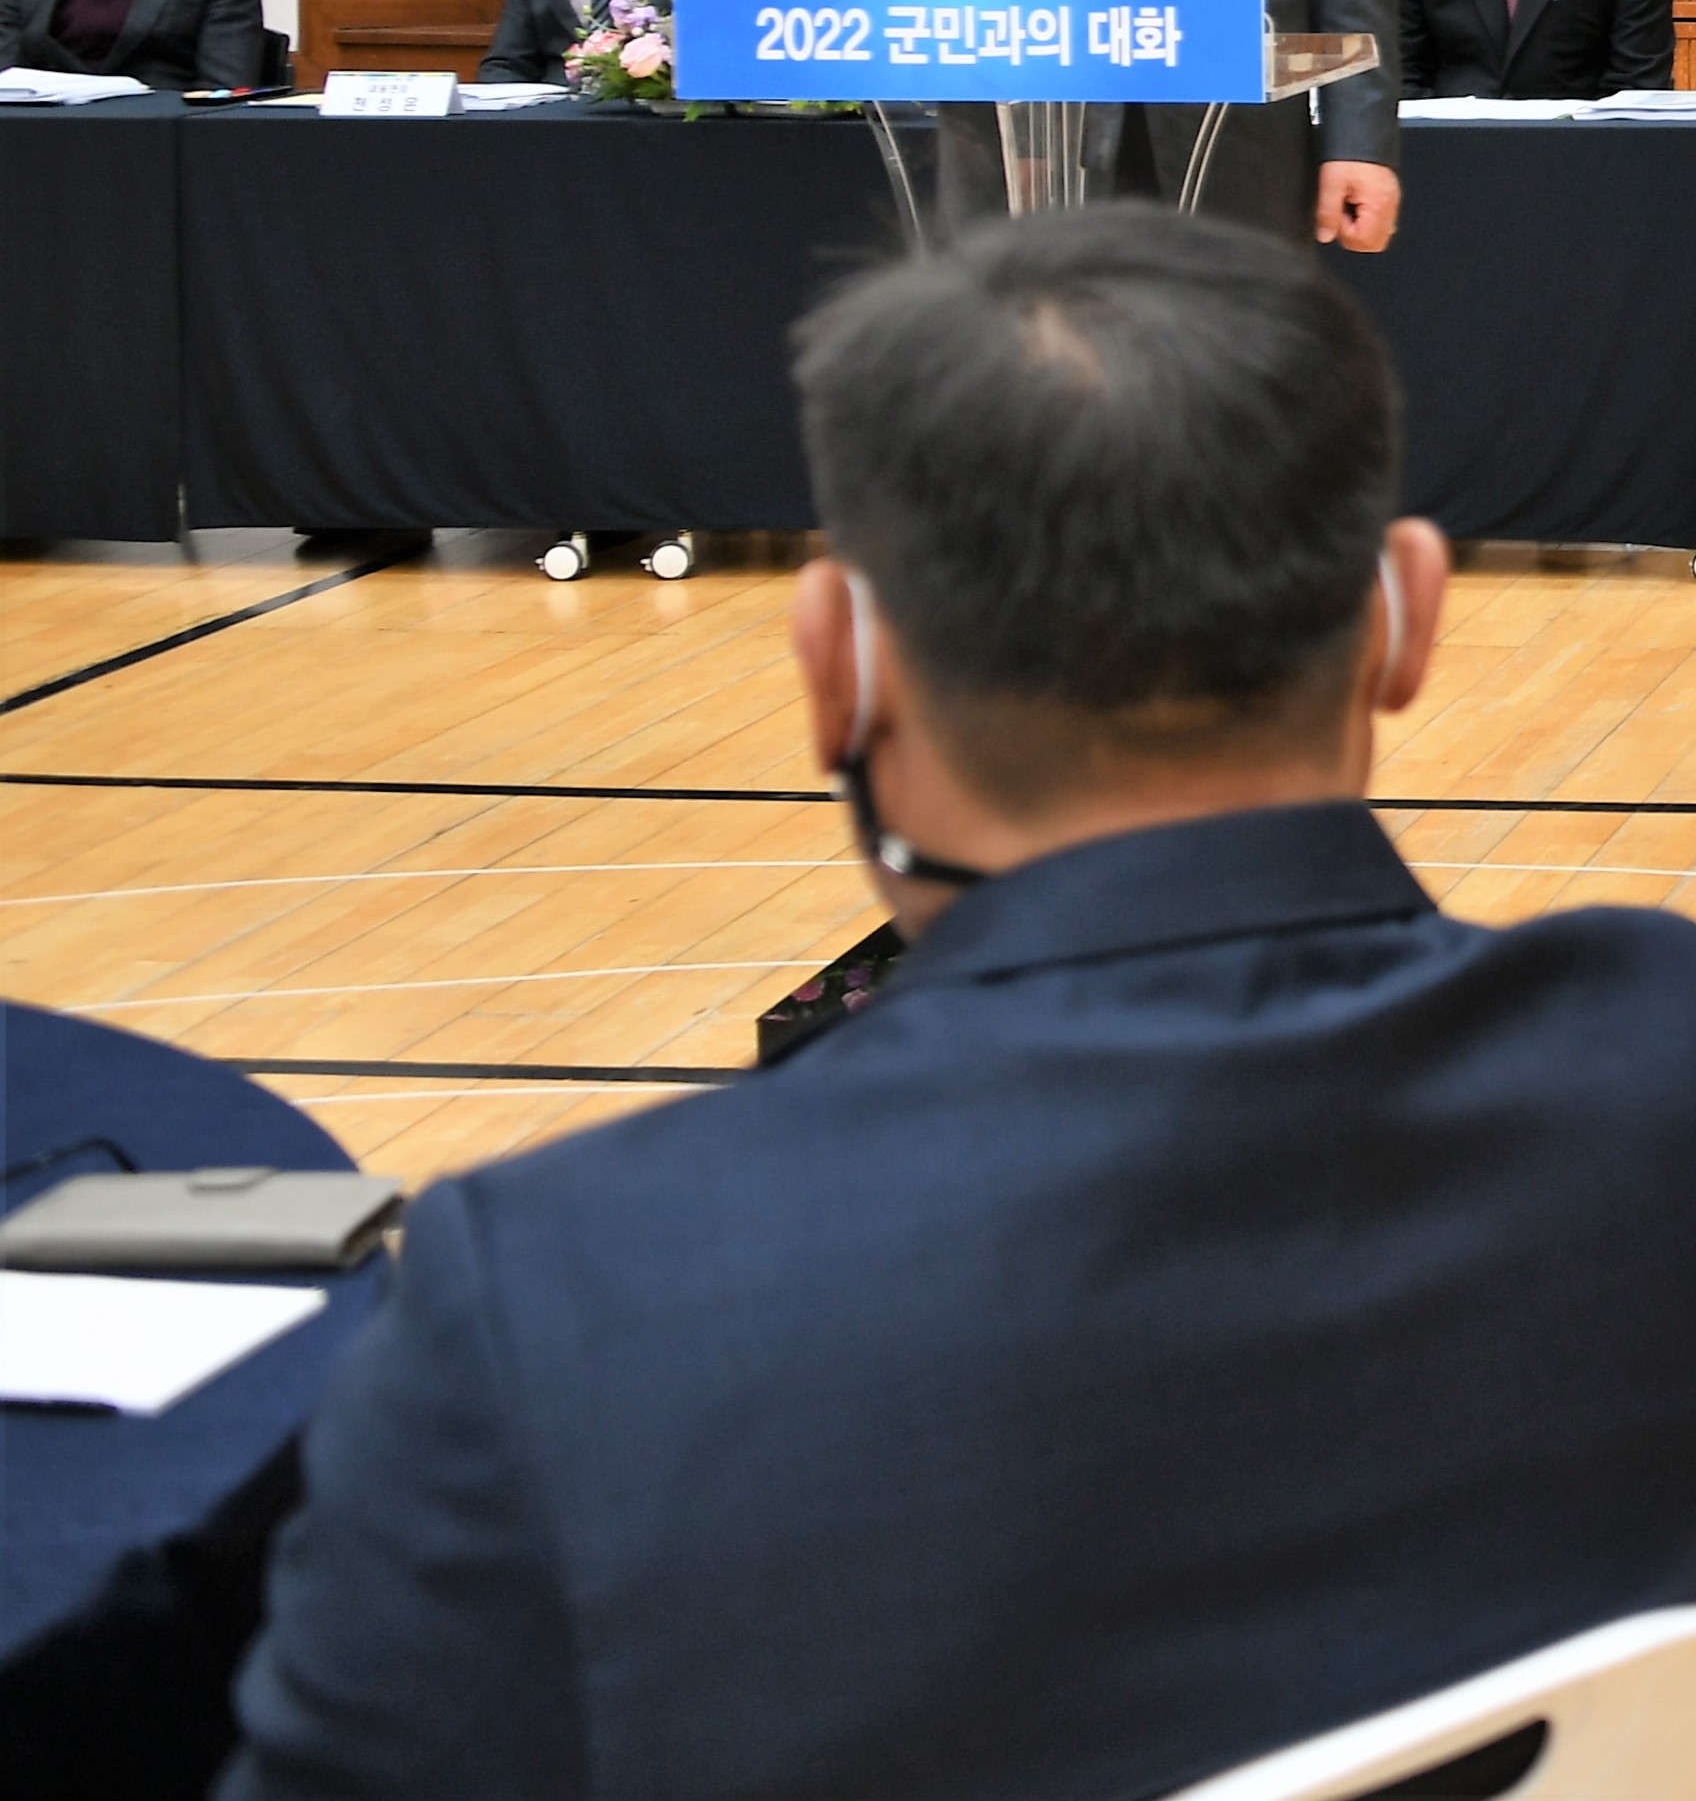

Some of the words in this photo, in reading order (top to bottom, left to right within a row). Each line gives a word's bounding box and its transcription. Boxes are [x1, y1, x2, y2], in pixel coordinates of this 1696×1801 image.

[754, 7, 870, 62] 2022
[883, 4, 1071, 68] 군민과의
[1087, 4, 1183, 68] 대화
